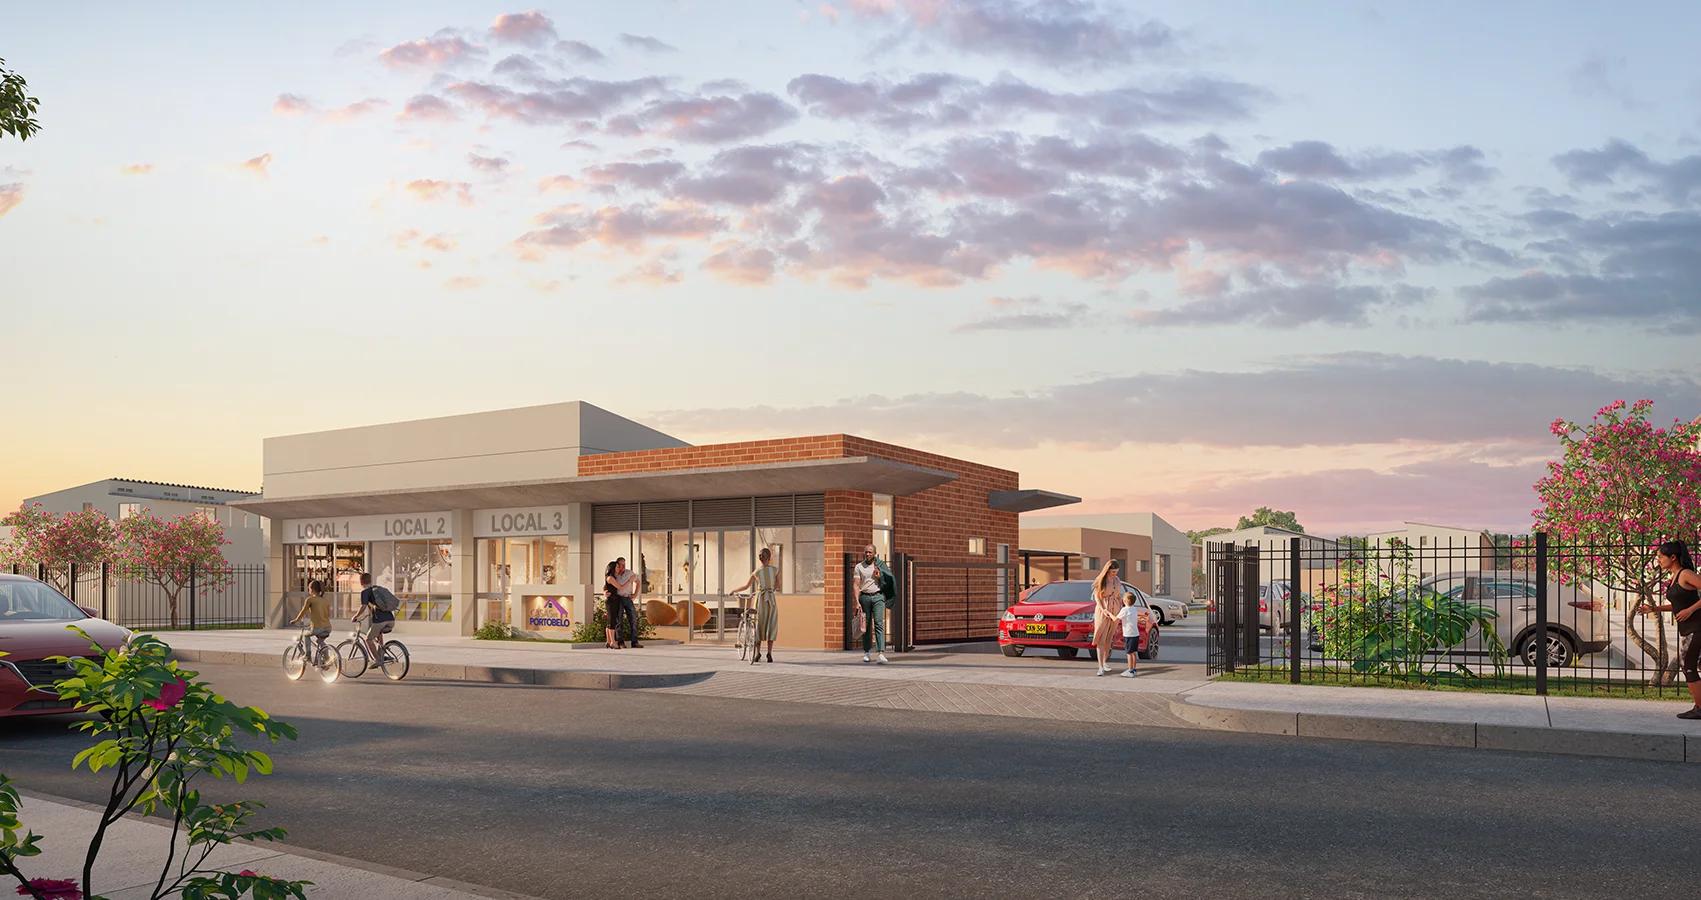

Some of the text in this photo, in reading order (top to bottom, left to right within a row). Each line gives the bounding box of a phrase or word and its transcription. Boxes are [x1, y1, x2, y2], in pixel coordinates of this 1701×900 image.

[297, 521, 350, 539] LOCAL 1
[384, 517, 445, 536] LOCAL 2
[492, 512, 562, 532] LOCAL 3
[529, 617, 570, 627] PORTOBELO
